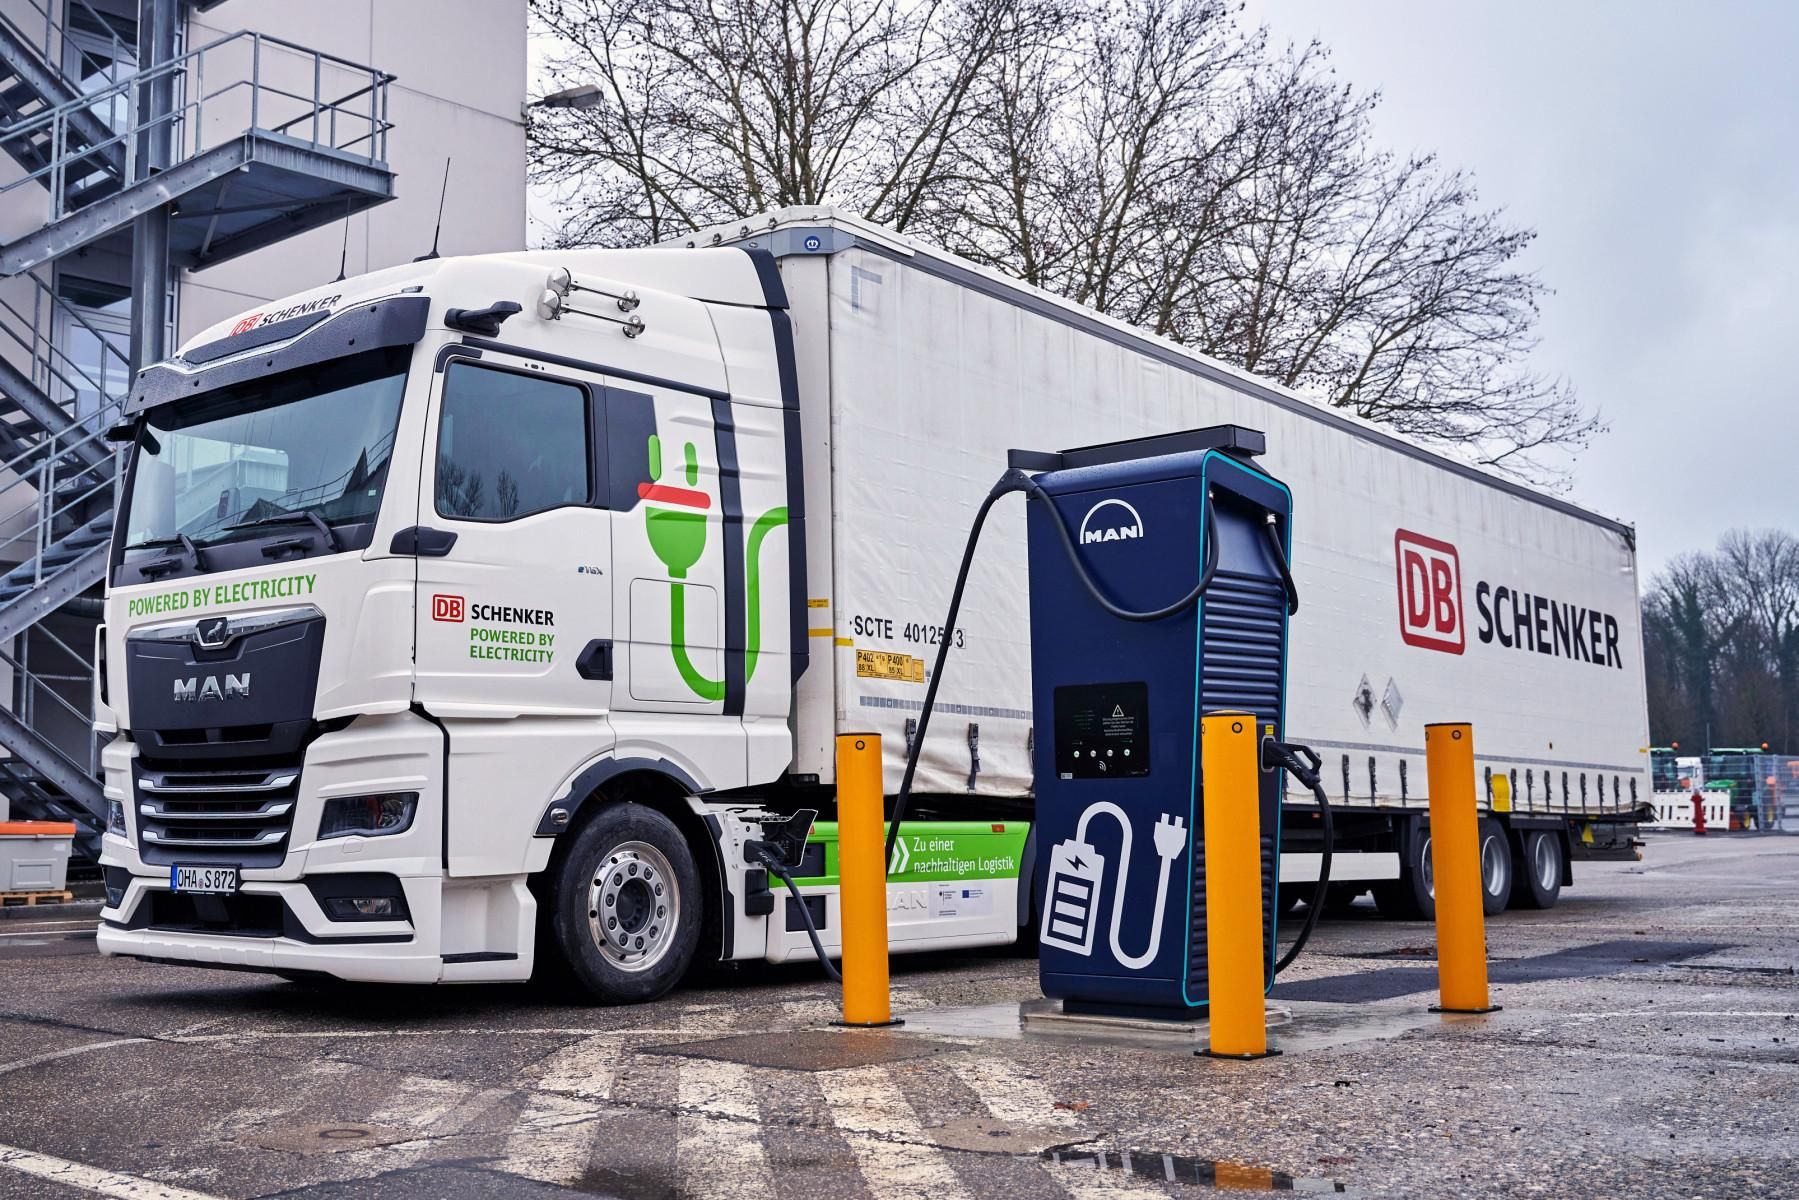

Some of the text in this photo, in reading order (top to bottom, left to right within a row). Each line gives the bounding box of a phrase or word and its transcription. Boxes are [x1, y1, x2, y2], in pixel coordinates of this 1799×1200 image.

[259, 295, 342, 327] SCHENKER
[1085, 525, 1138, 544] MAN
[129, 574, 317, 617] POWERED BY ELECTRICITY
[435, 597, 554, 626] DB SCHENKER
[1402, 546, 1623, 669] DB SCHENKER
[854, 615, 894, 640] SCTE
[470, 628, 554, 647] POWERED BY
[470, 645, 554, 663] ELECTRICITY
[173, 672, 250, 701] MAN
[913, 837, 954, 852] Zu einer
[914, 856, 1014, 875] nachhaltigen Logistik
[178, 869, 197, 888] OHA
[886, 891, 927, 910] AN
